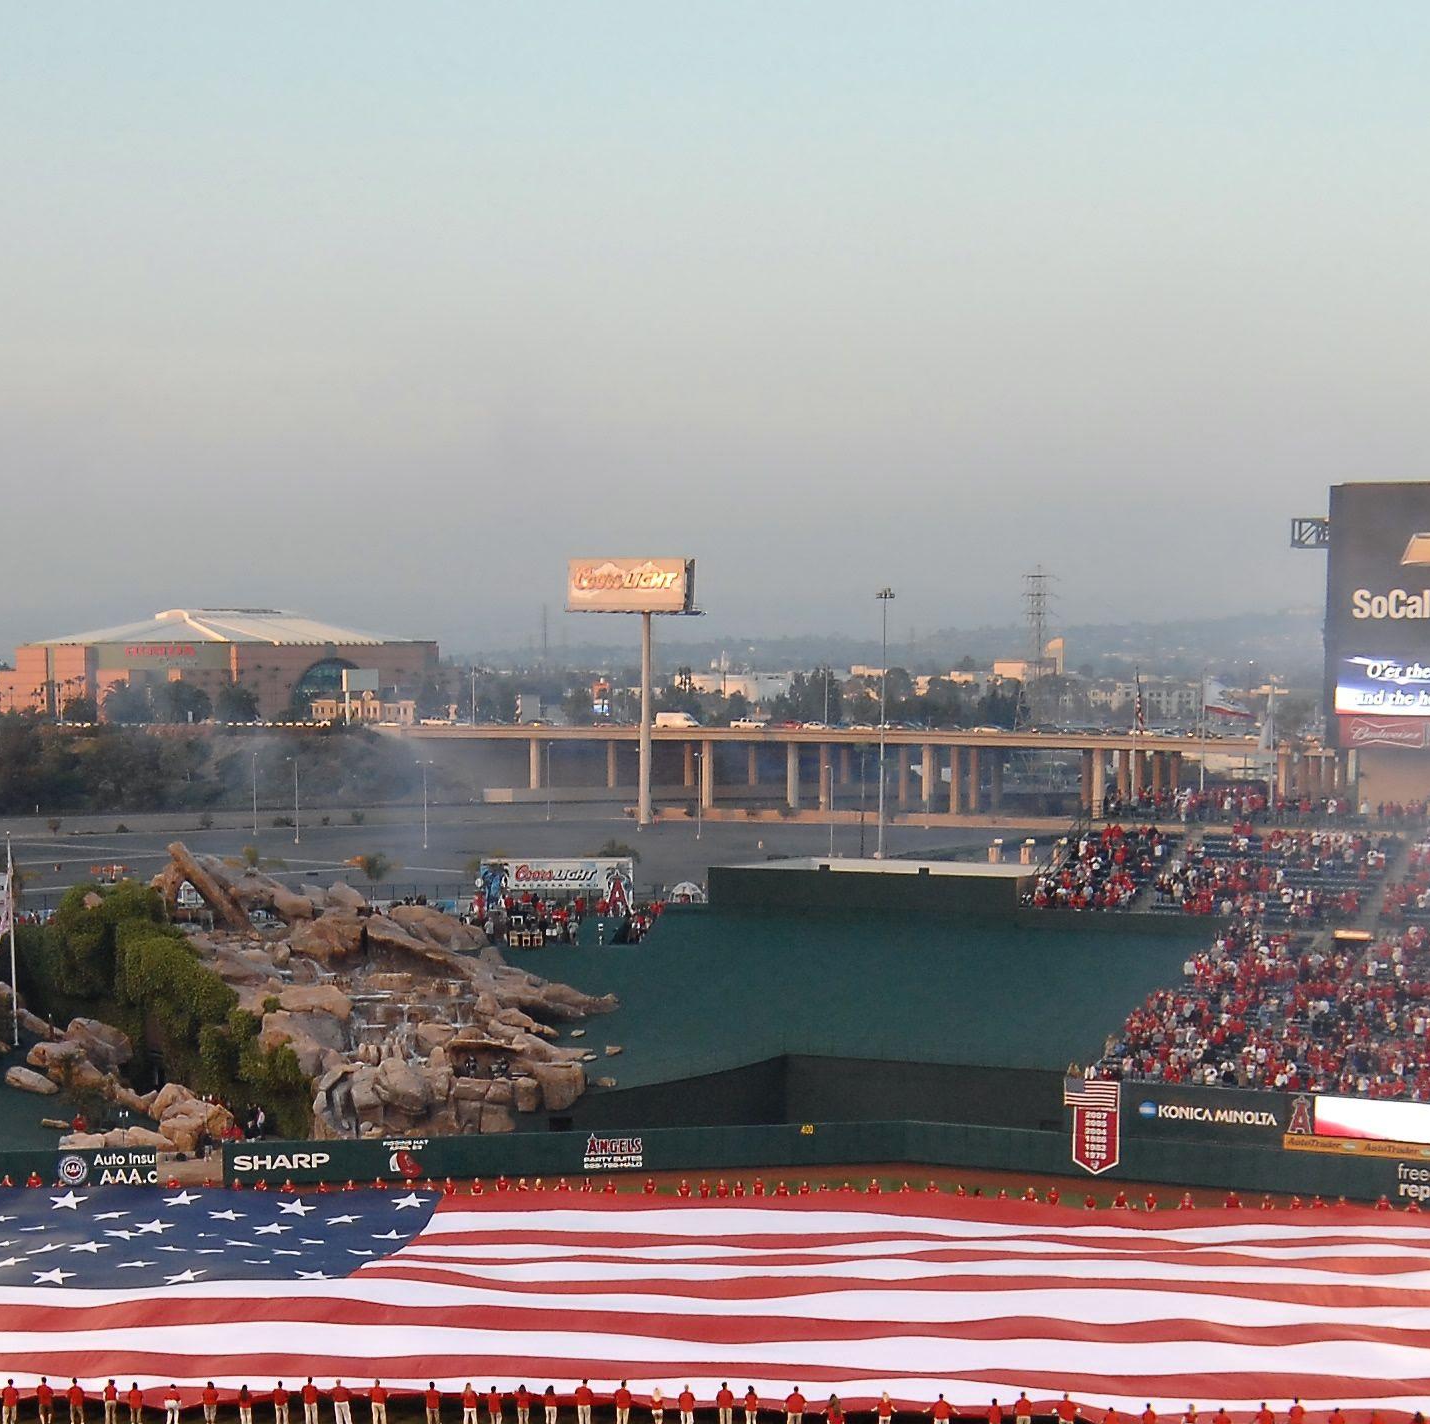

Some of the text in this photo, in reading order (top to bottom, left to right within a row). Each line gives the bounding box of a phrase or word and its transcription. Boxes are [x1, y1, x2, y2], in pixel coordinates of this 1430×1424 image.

[1387, 691, 1414, 706] the
[515, 865, 597, 881] Coors LIGHT
[1158, 1105, 1277, 1126] KONICA MINOLTA
[584, 1133, 643, 1156] ANGELS
[1287, 1137, 1341, 1150] AutoTrader
[1364, 1143, 1419, 1155] AutoTrader
[94, 1153, 126, 1166] Auto
[234, 1153, 330, 1171] SHARP
